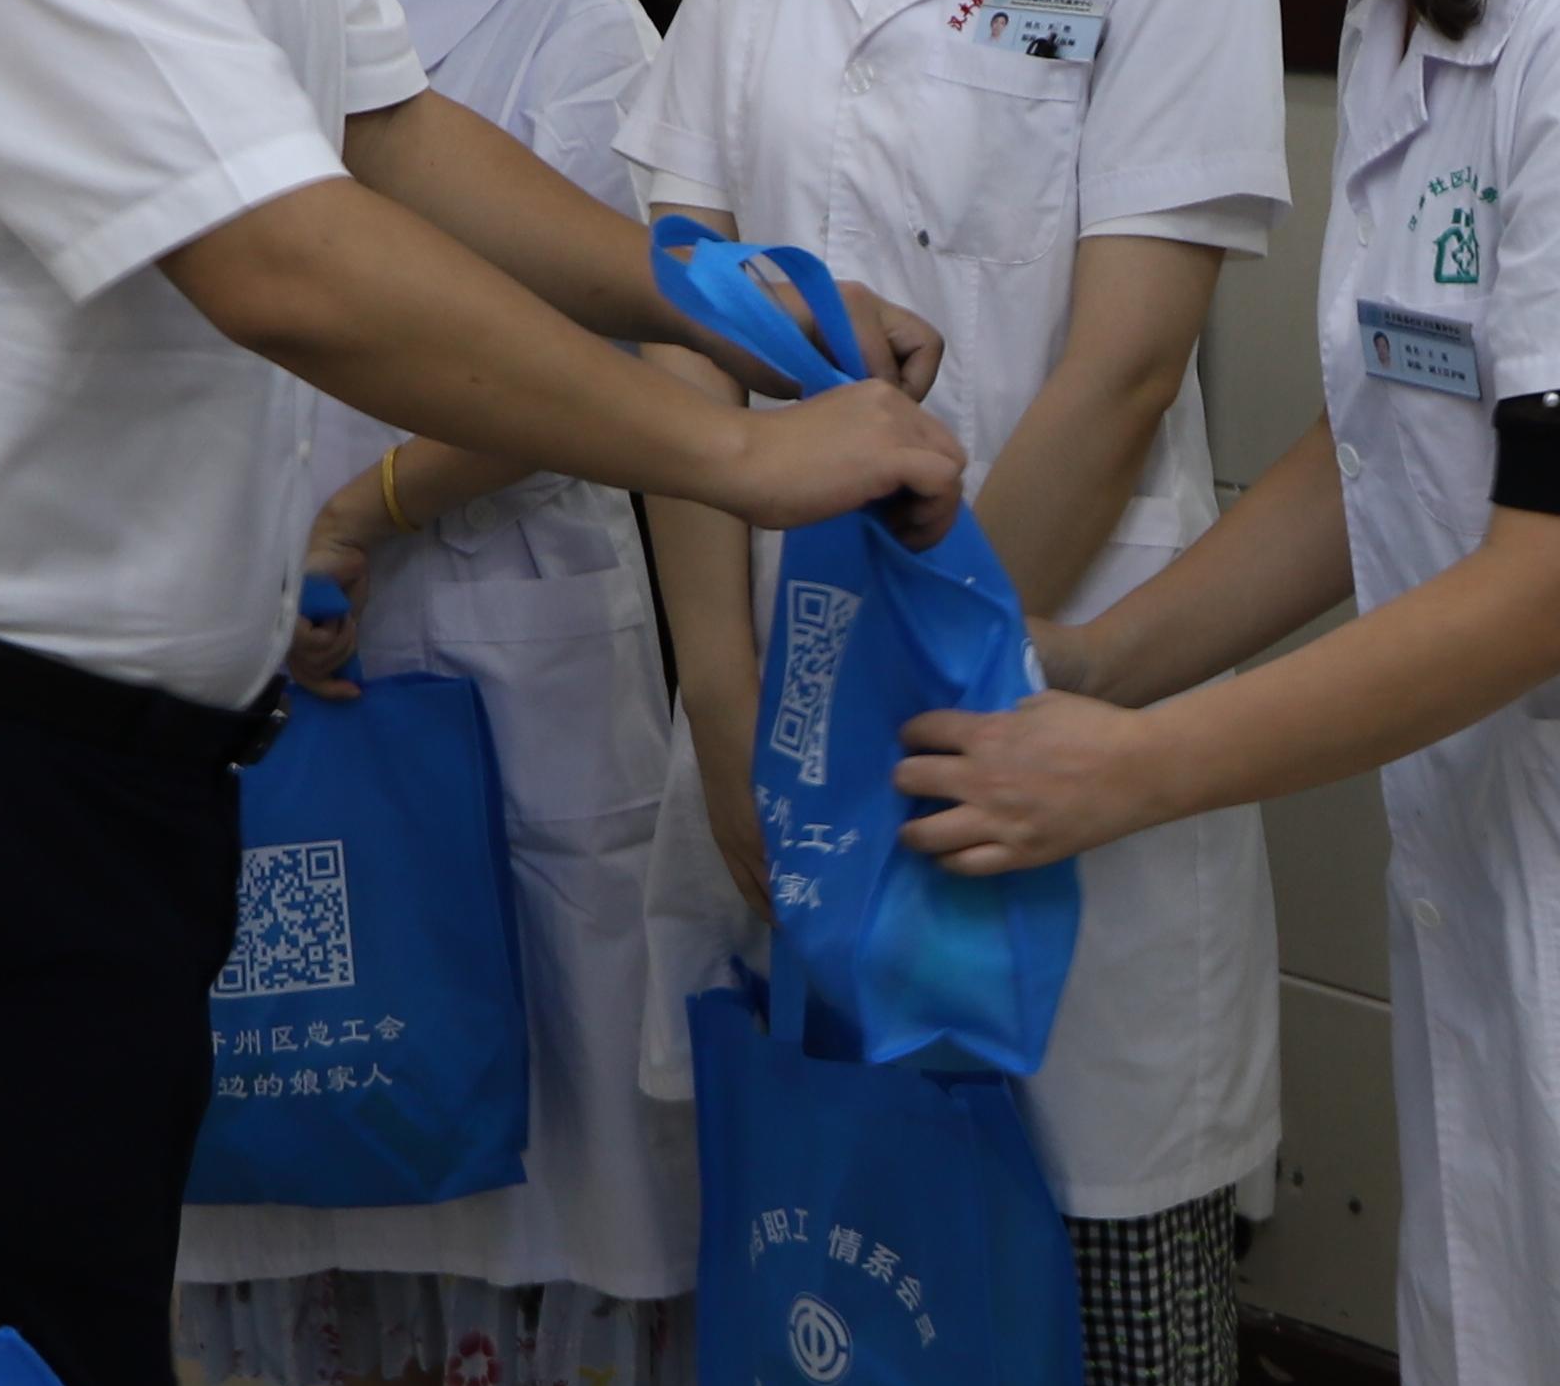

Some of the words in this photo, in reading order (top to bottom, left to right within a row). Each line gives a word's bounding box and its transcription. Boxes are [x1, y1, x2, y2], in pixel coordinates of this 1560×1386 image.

[216, 1059, 395, 1102] 边的娘家人
